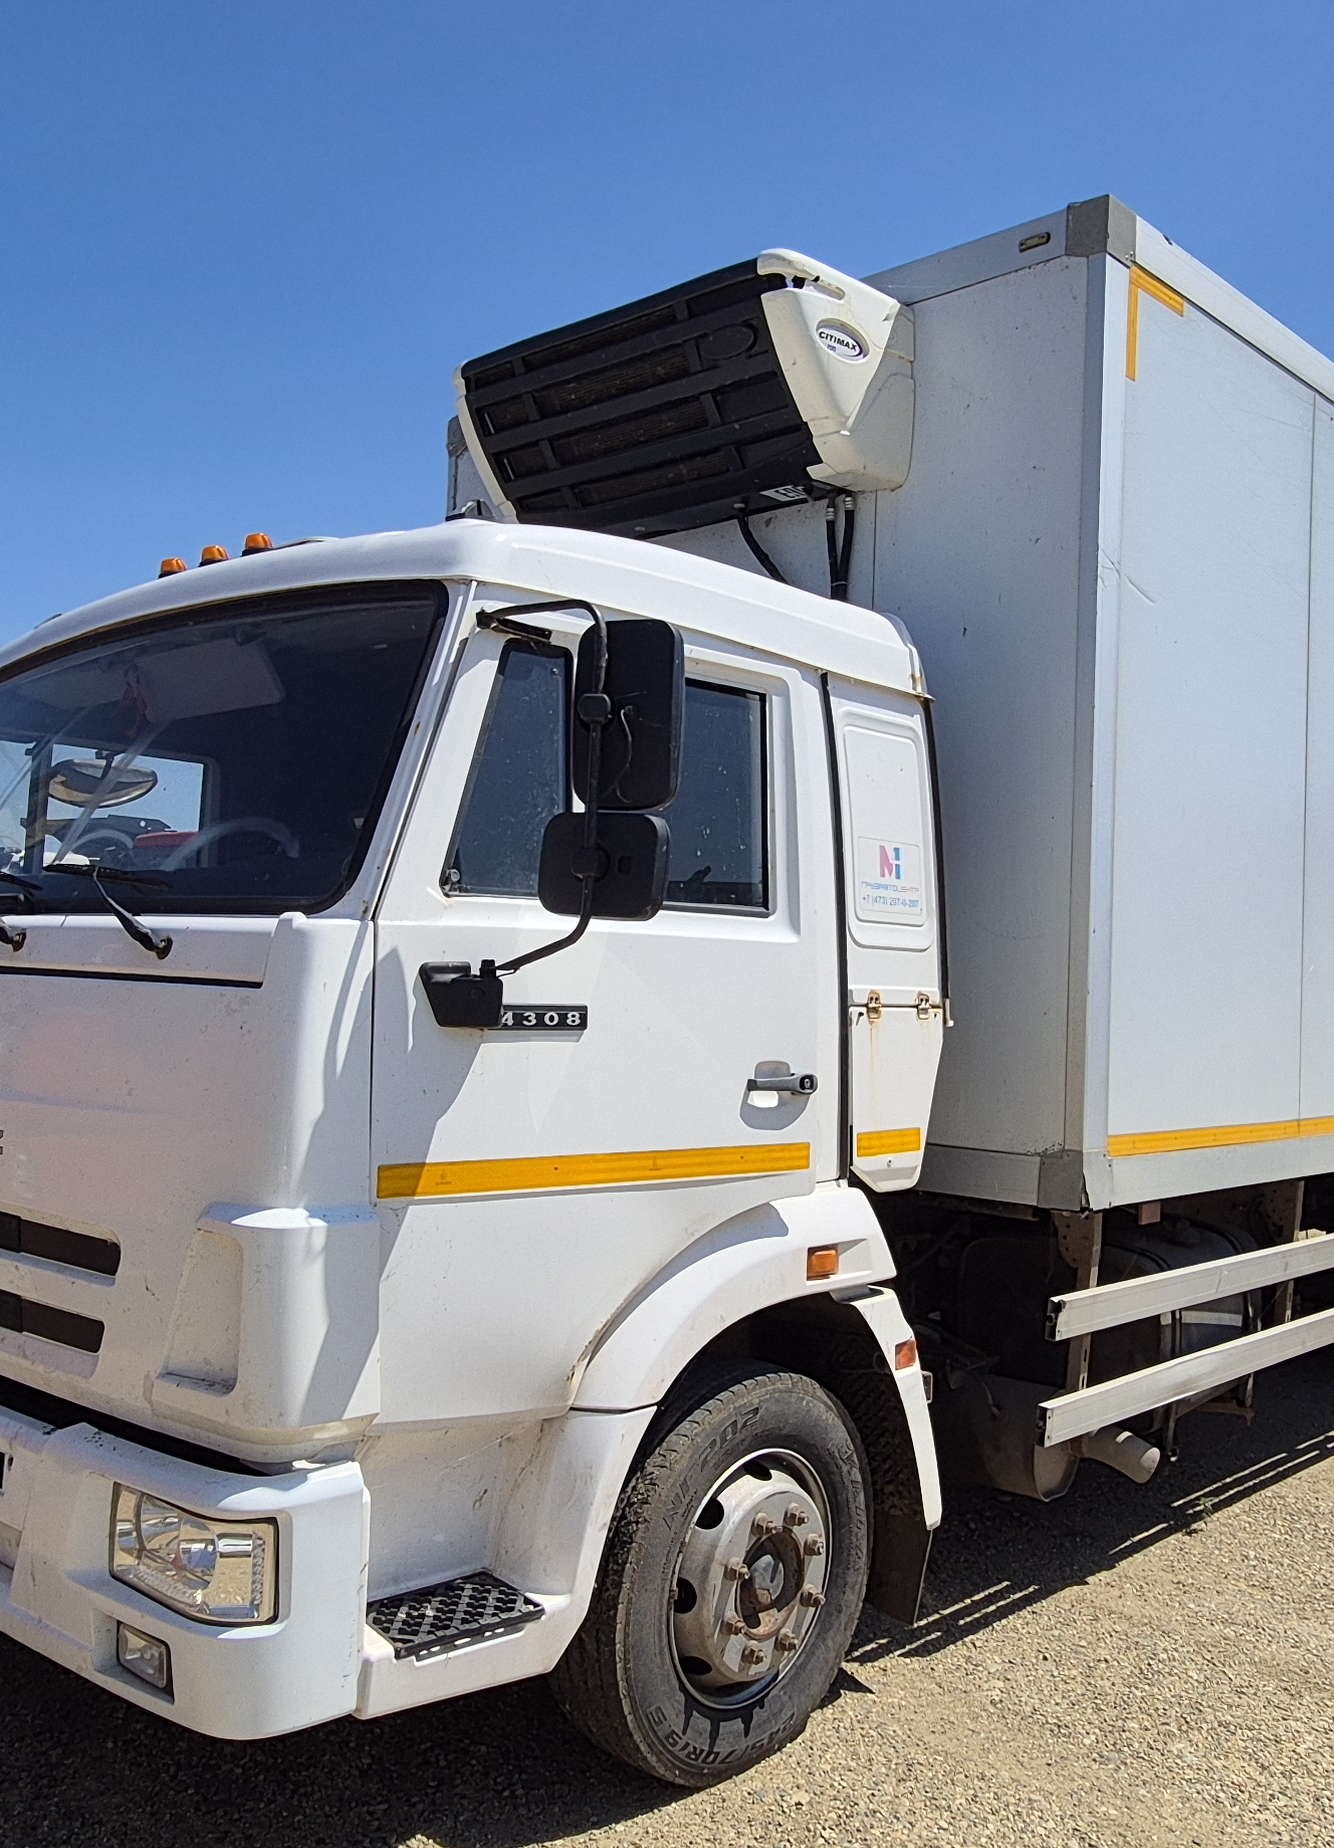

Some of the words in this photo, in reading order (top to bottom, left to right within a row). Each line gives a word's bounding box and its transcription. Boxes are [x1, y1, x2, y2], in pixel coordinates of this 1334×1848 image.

[819, 331, 857, 352] CITIMAX
[501, 1011, 582, 1027] 4308
[698, 1406, 760, 1473] 202
